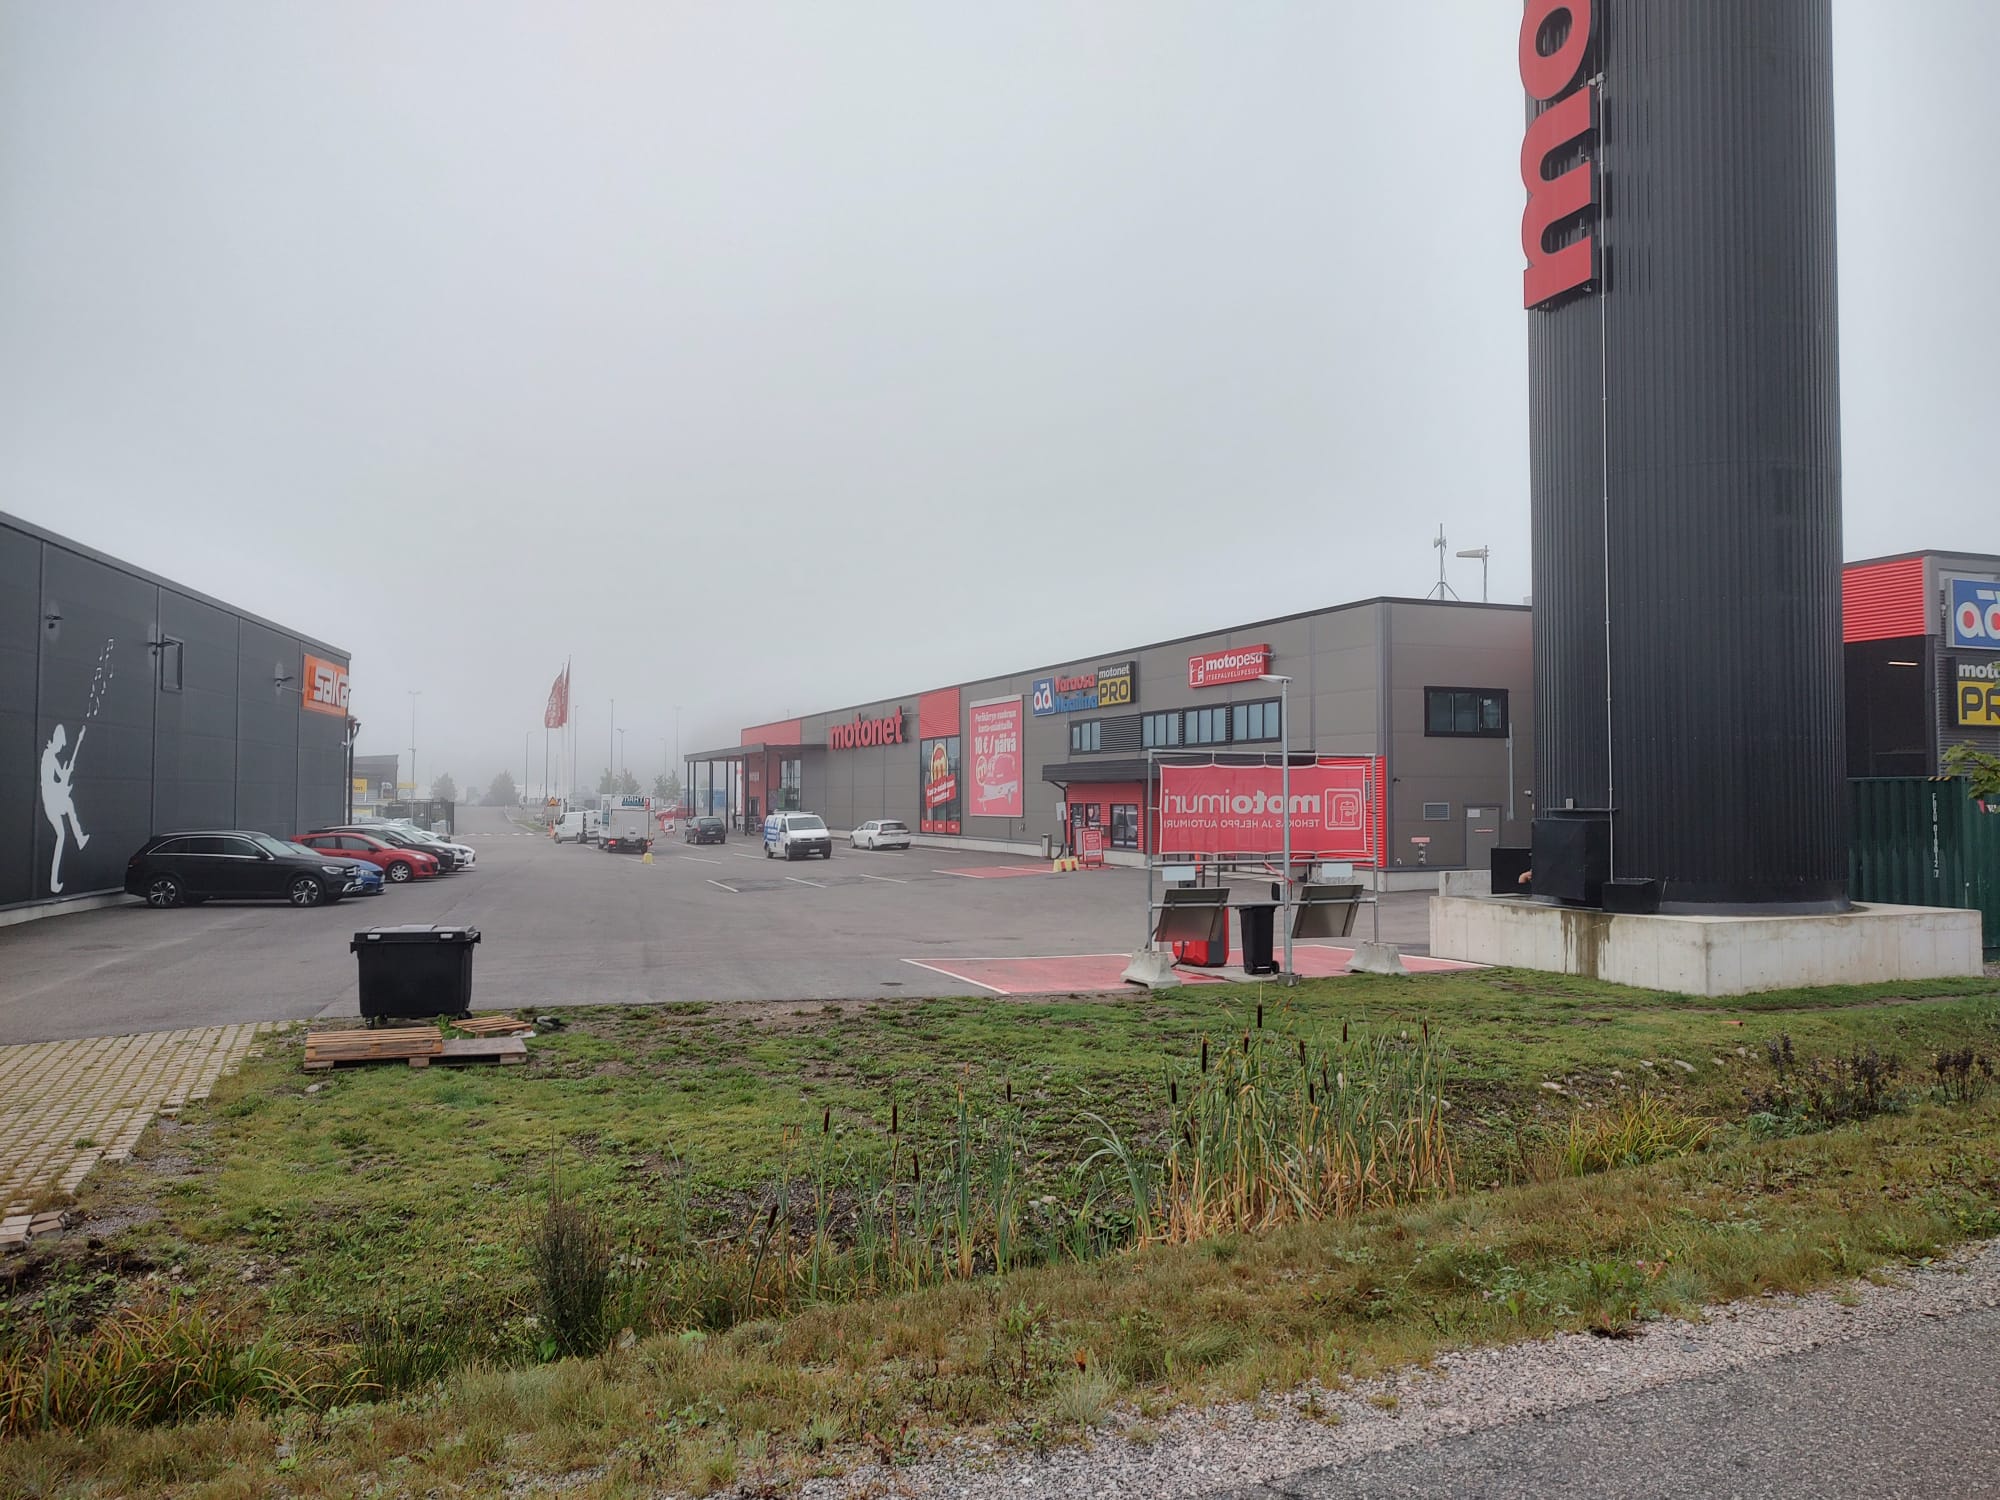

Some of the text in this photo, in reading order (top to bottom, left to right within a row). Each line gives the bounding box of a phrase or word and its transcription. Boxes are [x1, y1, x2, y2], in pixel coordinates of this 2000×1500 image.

[1206, 652, 1262, 670] motopesu
[1099, 664, 1129, 678] motonet
[1206, 668, 1262, 680] ITSEPALVELUPESULA
[1100, 680, 1128, 703] PRO
[829, 706, 903, 750] motonet
